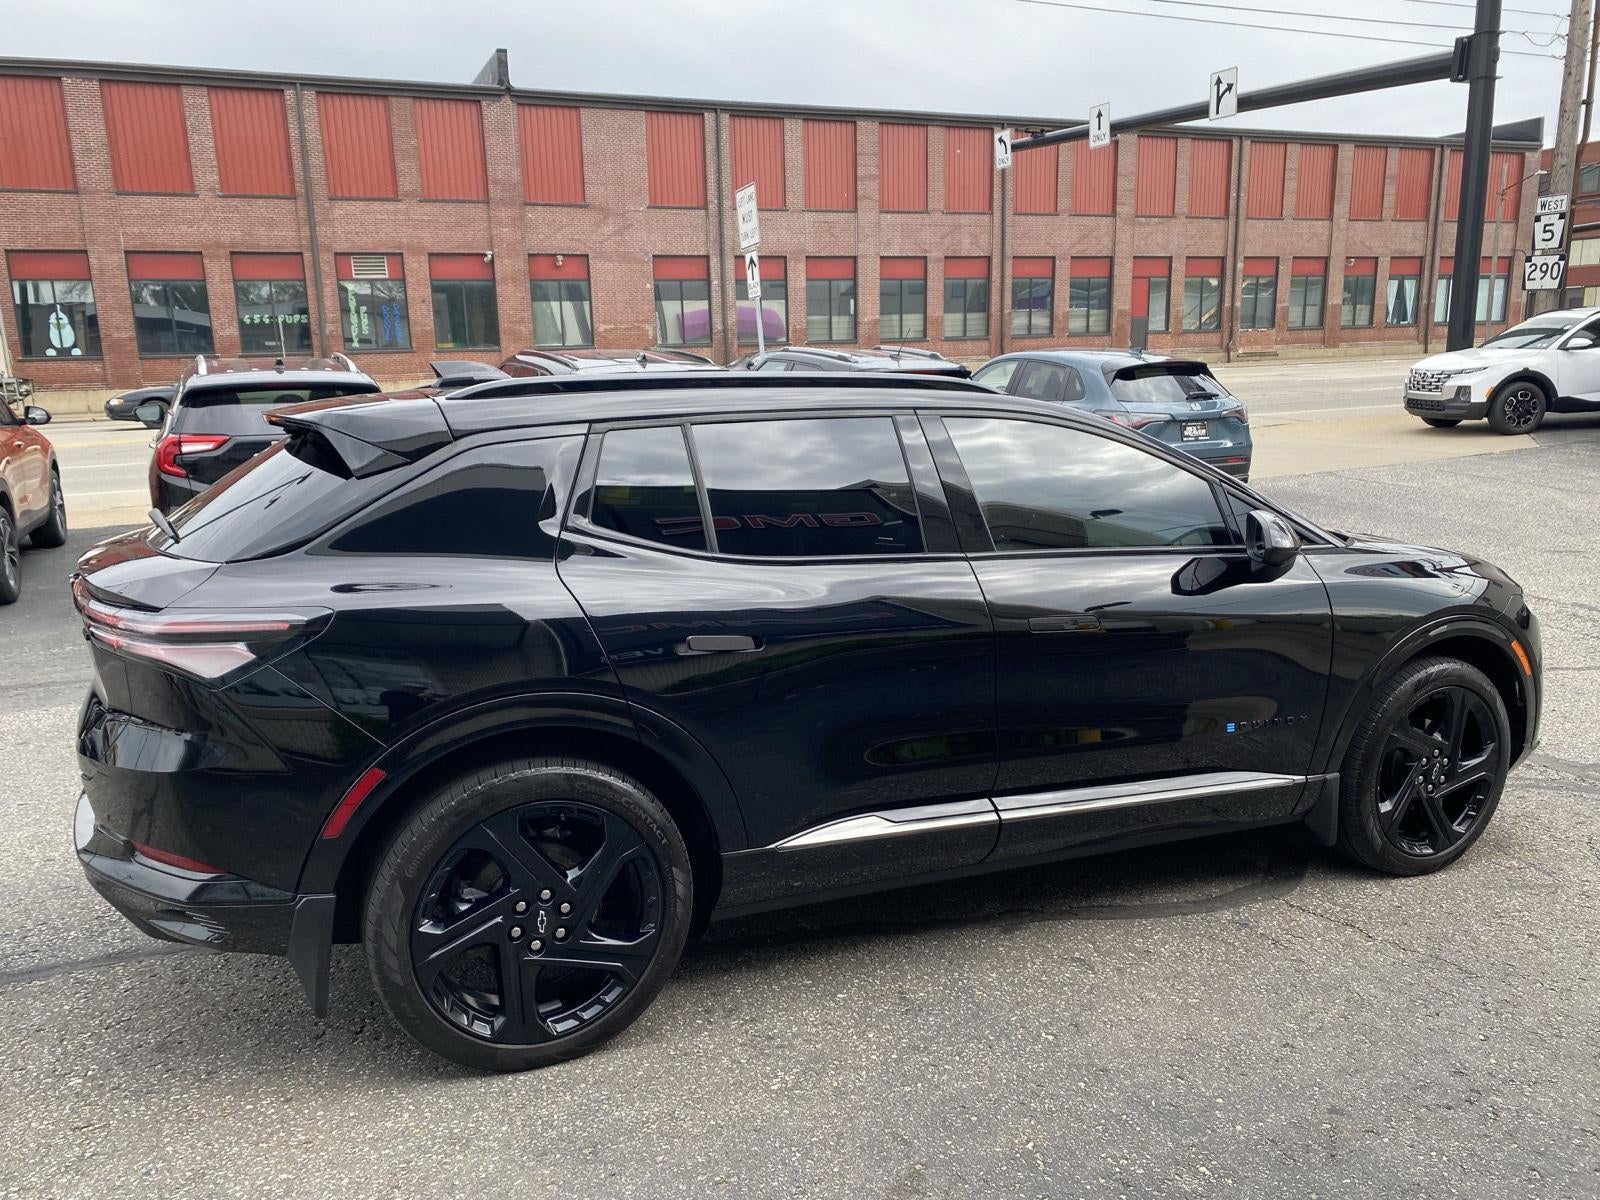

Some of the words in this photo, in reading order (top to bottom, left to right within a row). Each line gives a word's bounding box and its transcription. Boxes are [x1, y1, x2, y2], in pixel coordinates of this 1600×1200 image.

[1092, 132, 1107, 143] ONLY
[998, 157, 1009, 166] ONLY
[1540, 199, 1564, 211] WEST
[1541, 223, 1555, 242] 5
[1527, 262, 1560, 281] 290
